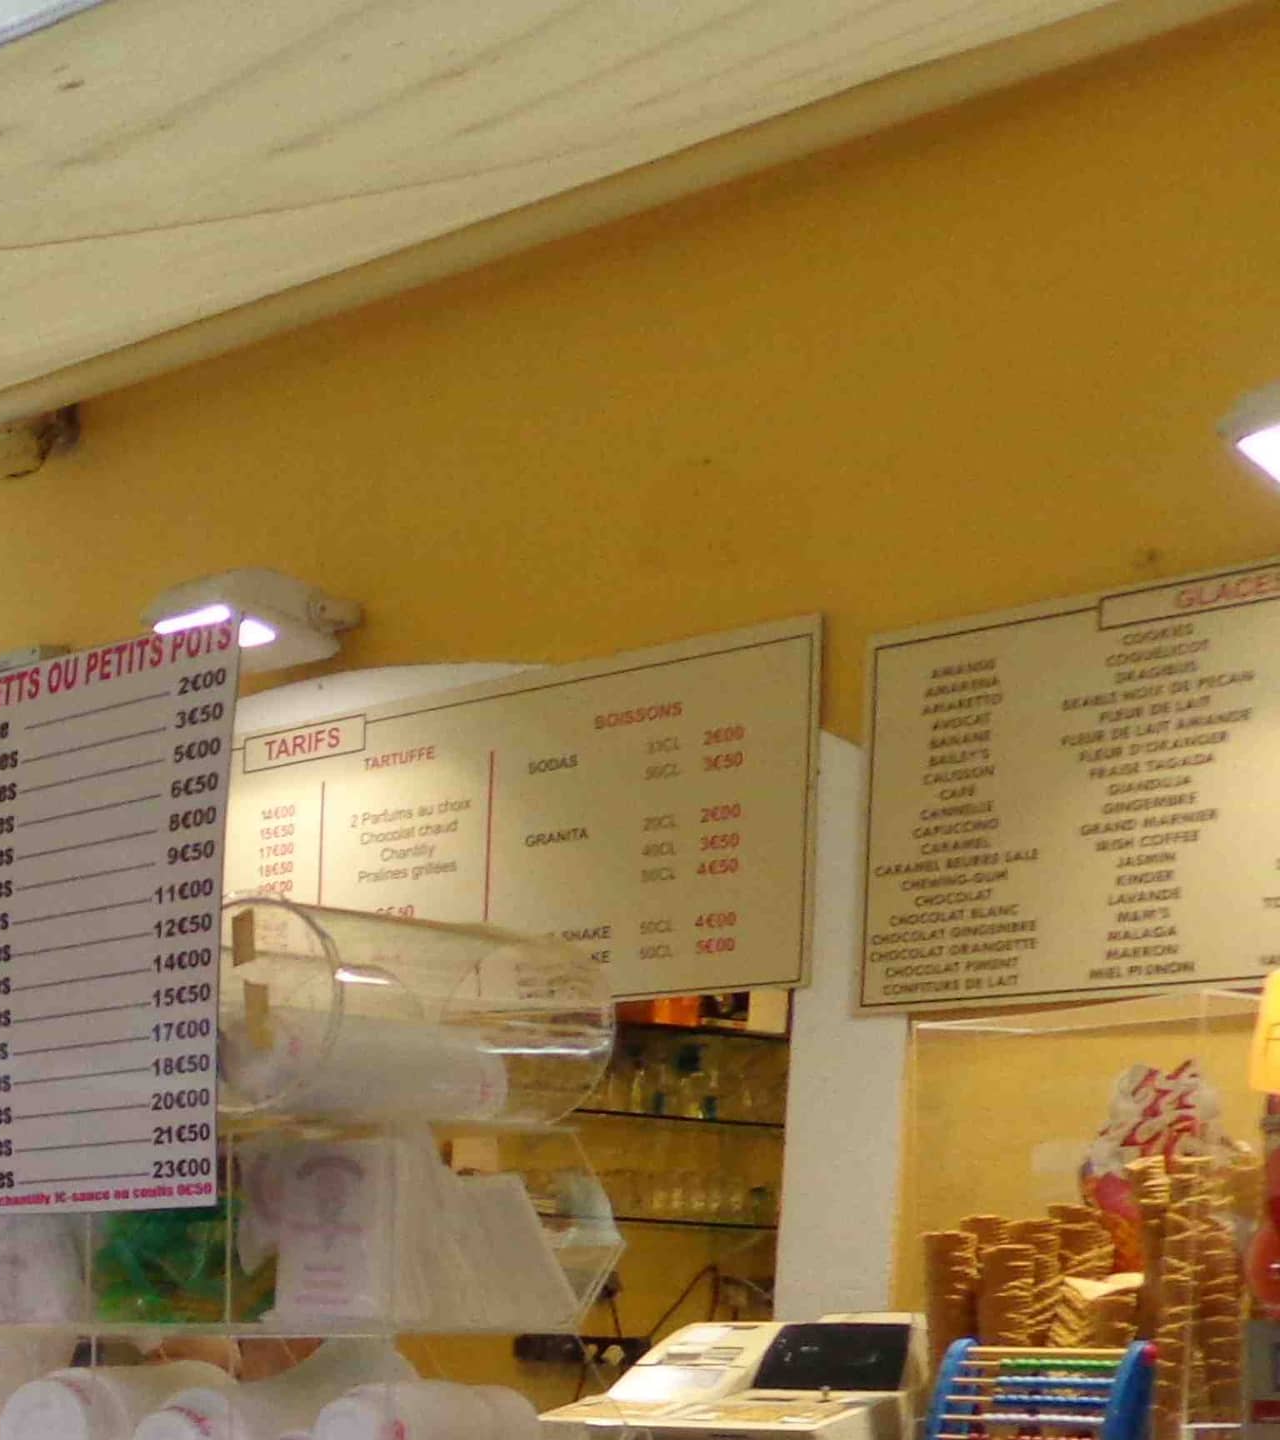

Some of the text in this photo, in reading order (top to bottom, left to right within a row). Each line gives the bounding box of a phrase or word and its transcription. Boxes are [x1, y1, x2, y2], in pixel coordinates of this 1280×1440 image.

[1177, 574, 1280, 608] GLACE
[48, 658, 79, 694] OU
[86, 635, 164, 686] PETITS
[178, 668, 226, 696] 2€00
[175, 702, 224, 729] 3€50
[594, 702, 684, 730] BOISSONS
[174, 737, 221, 764] 5€00
[265, 728, 340, 761] TARIFS
[364, 745, 437, 771] TARTUFFE
[528, 754, 578, 775] SODAS
[703, 752, 744, 772] 3€50
[170, 772, 219, 798] 6€50
[169, 805, 217, 832] 8€00
[361, 798, 472, 825] Parfums au choix
[1080, 808, 1218, 836] GRAND MARNIER
[360, 819, 459, 846] Chocolat chaud
[525, 827, 589, 848] GRANITA
[700, 833, 740, 852] 3€50
[1140, 830, 1200, 848] COFFEE
[167, 840, 215, 865] 9€50
[380, 842, 437, 863] Chantilly
[1116, 852, 1176, 868] JASMIN
[358, 866, 408, 884] Pralines
[696, 858, 739, 876] 4€50
[875, 860, 939, 877] CARAMEL
[1116, 870, 1174, 886] KINDER
[154, 878, 213, 904] 11€00
[915, 888, 993, 907] CHOCOLAT
[1108, 887, 1182, 906] LAVANDE
[153, 913, 212, 940] 12€50
[890, 910, 965, 926] CHOCOLAT
[562, 926, 611, 942] SHAKE
[872, 928, 945, 945] CHOCOLAT
[1107, 926, 1177, 941] MALAGA
[152, 948, 212, 974] 14€00
[871, 946, 944, 962] CHOCOLAT
[1106, 944, 1179, 960] MARRON
[886, 961, 960, 977] CHOCOLAT
[152, 983, 211, 1008] 15€50
[151, 1018, 210, 1042] 17€00
[151, 1054, 210, 1077] 18€50
[151, 1088, 210, 1111] 20€00
[153, 1123, 210, 1145] 21€50
[153, 1158, 211, 1179] 23€00
